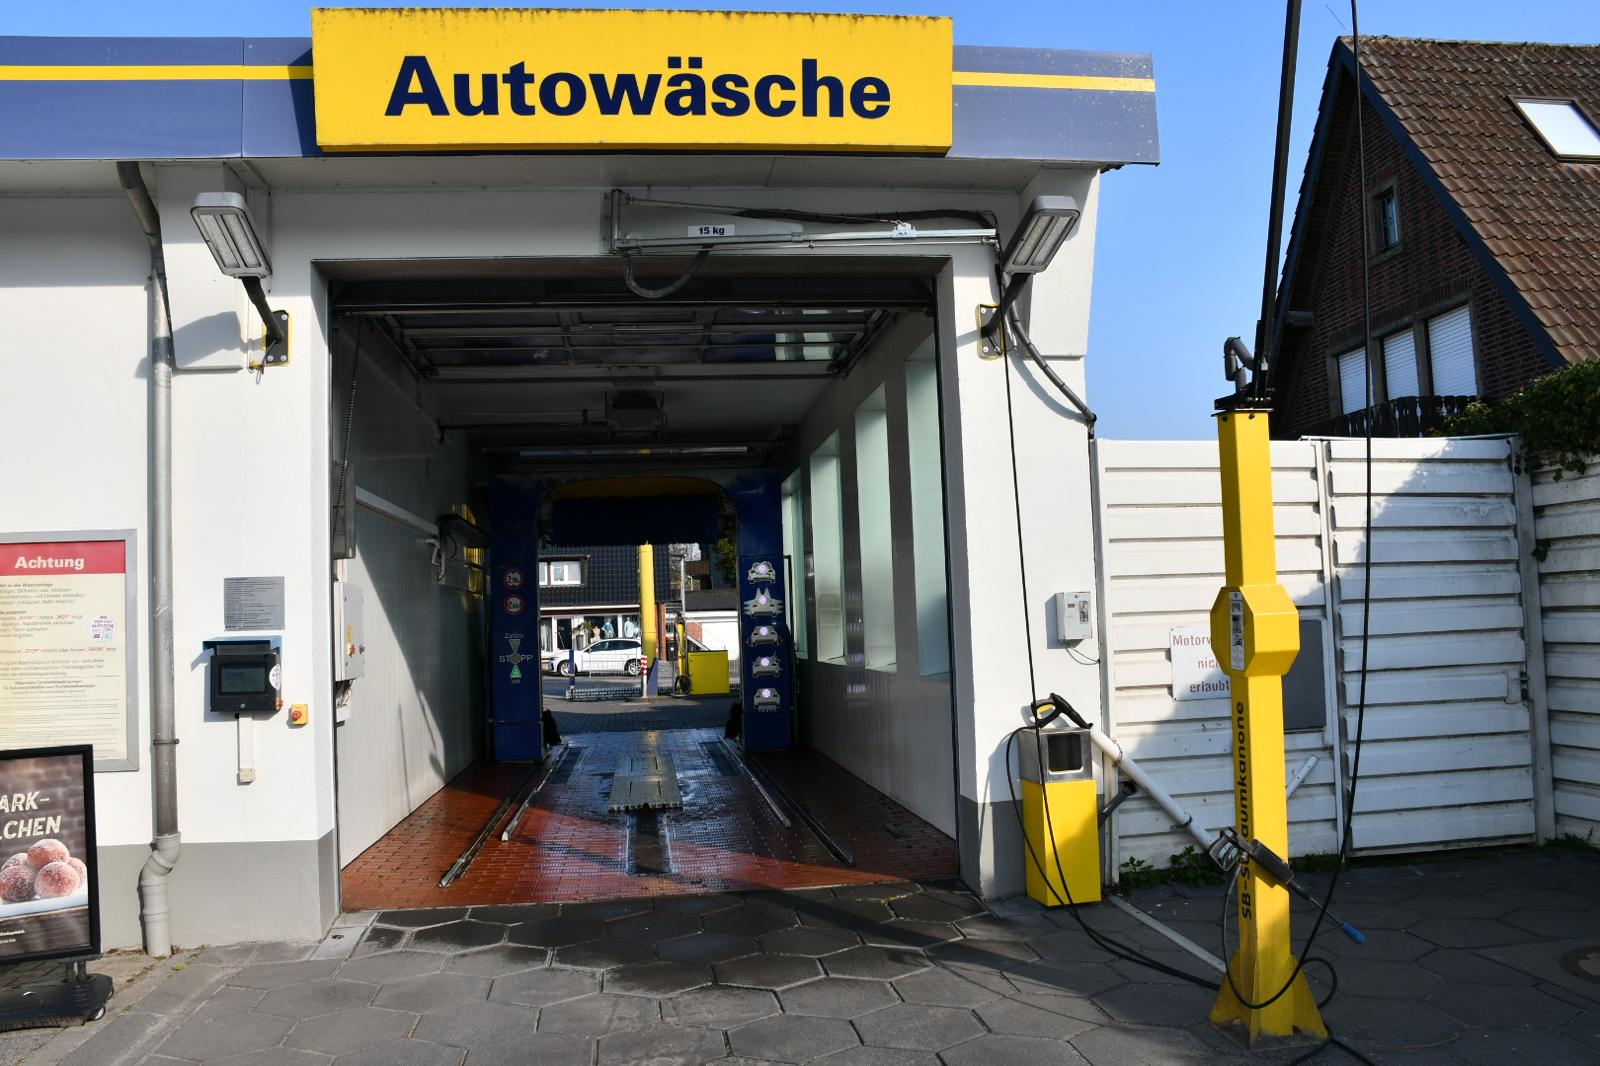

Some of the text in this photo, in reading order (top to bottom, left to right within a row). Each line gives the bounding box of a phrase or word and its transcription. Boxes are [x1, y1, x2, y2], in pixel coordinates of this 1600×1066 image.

[385, 55, 890, 118] Autowäsche
[698, 226, 725, 236] 15 kg
[14, 556, 85, 570] Achtung
[1198, 657, 1218, 668] nic
[1190, 680, 1230, 693] erlaubt
[1237, 701, 1252, 921] SB-Saumkanone
